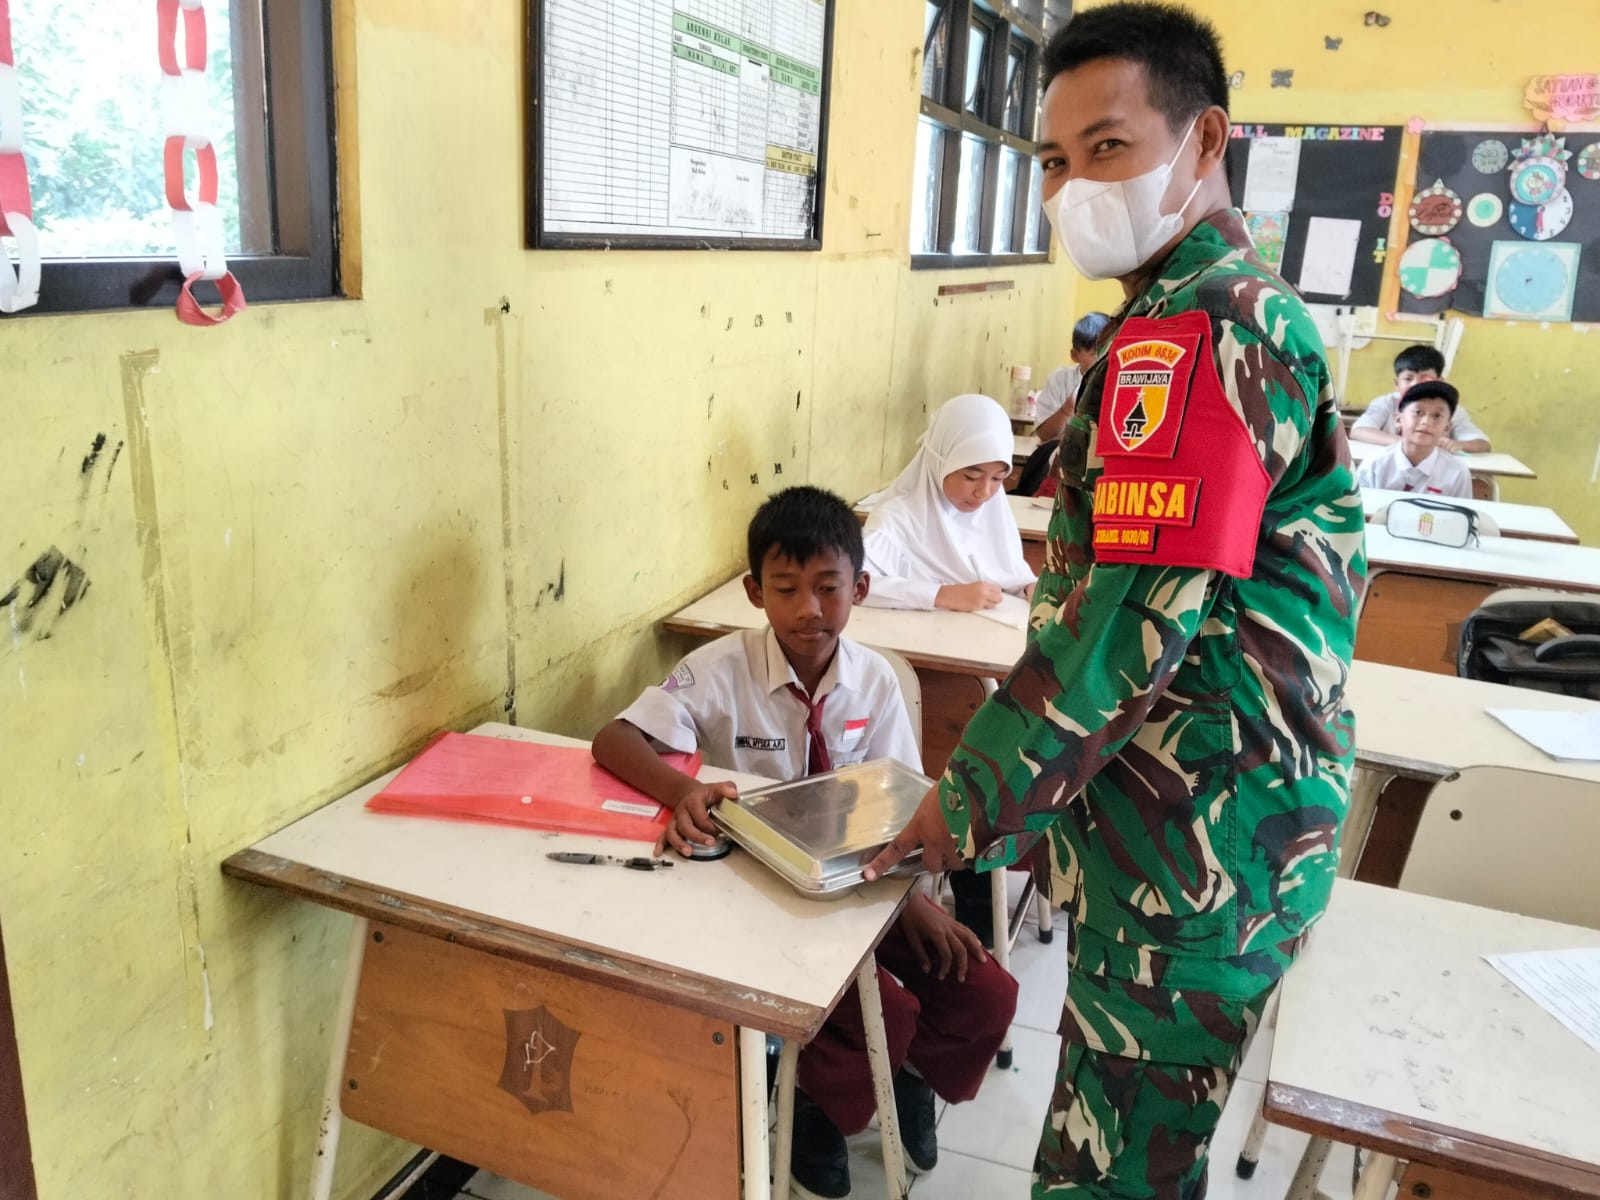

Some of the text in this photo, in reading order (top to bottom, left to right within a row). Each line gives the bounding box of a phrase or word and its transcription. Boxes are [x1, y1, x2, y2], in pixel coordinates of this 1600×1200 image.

[1231, 125, 1385, 141] ALL MAGAZINE
[1121, 345, 1152, 363] KODIM
[1120, 374, 1168, 384] BRAWIJAYA
[1094, 481, 1186, 518] ABINSA
